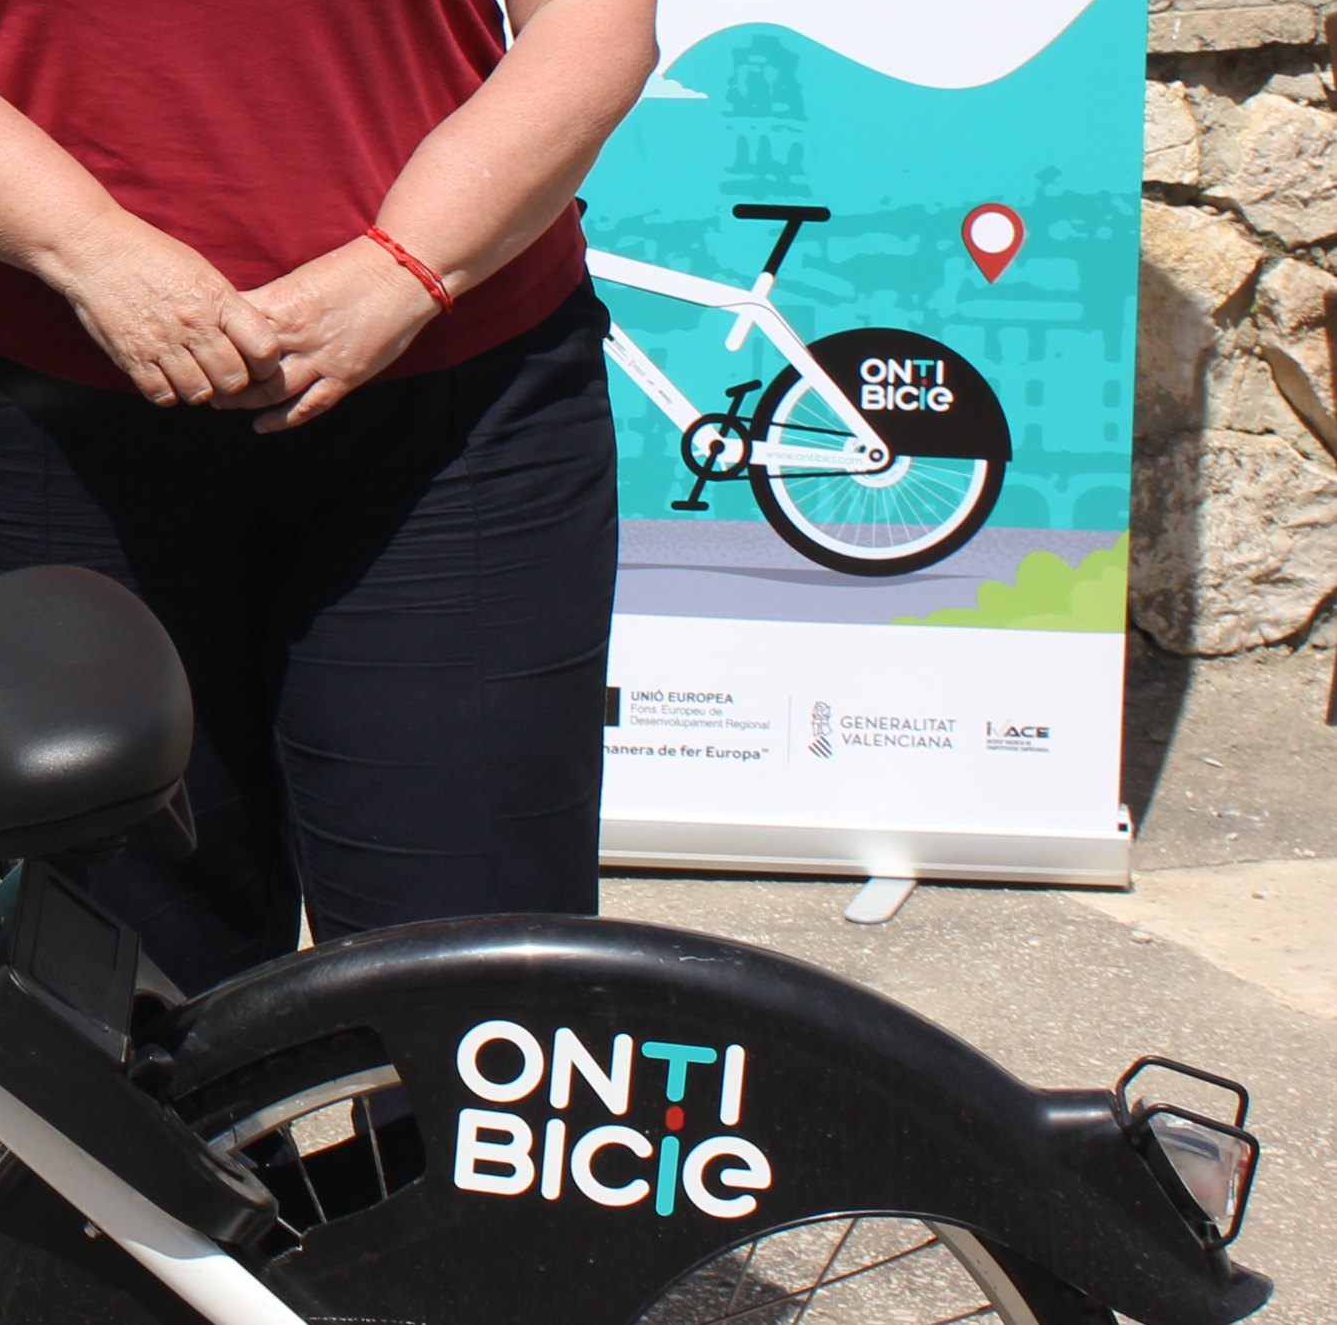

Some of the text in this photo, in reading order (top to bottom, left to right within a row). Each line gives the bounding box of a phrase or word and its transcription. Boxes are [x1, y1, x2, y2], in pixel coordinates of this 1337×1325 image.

[860, 358, 944, 384] ONTI
[668, 691, 734, 704] EUROPEA
[630, 704, 723, 717] Fons Europeu de
[629, 716, 771, 731] Desenvolupament Regional
[840, 715, 956, 733] GENERALITAT
[841, 732, 954, 749] VALENCIANA
[658, 744, 677, 757] de
[680, 745, 702, 758] fer
[457, 1020, 746, 1126] ONTI
